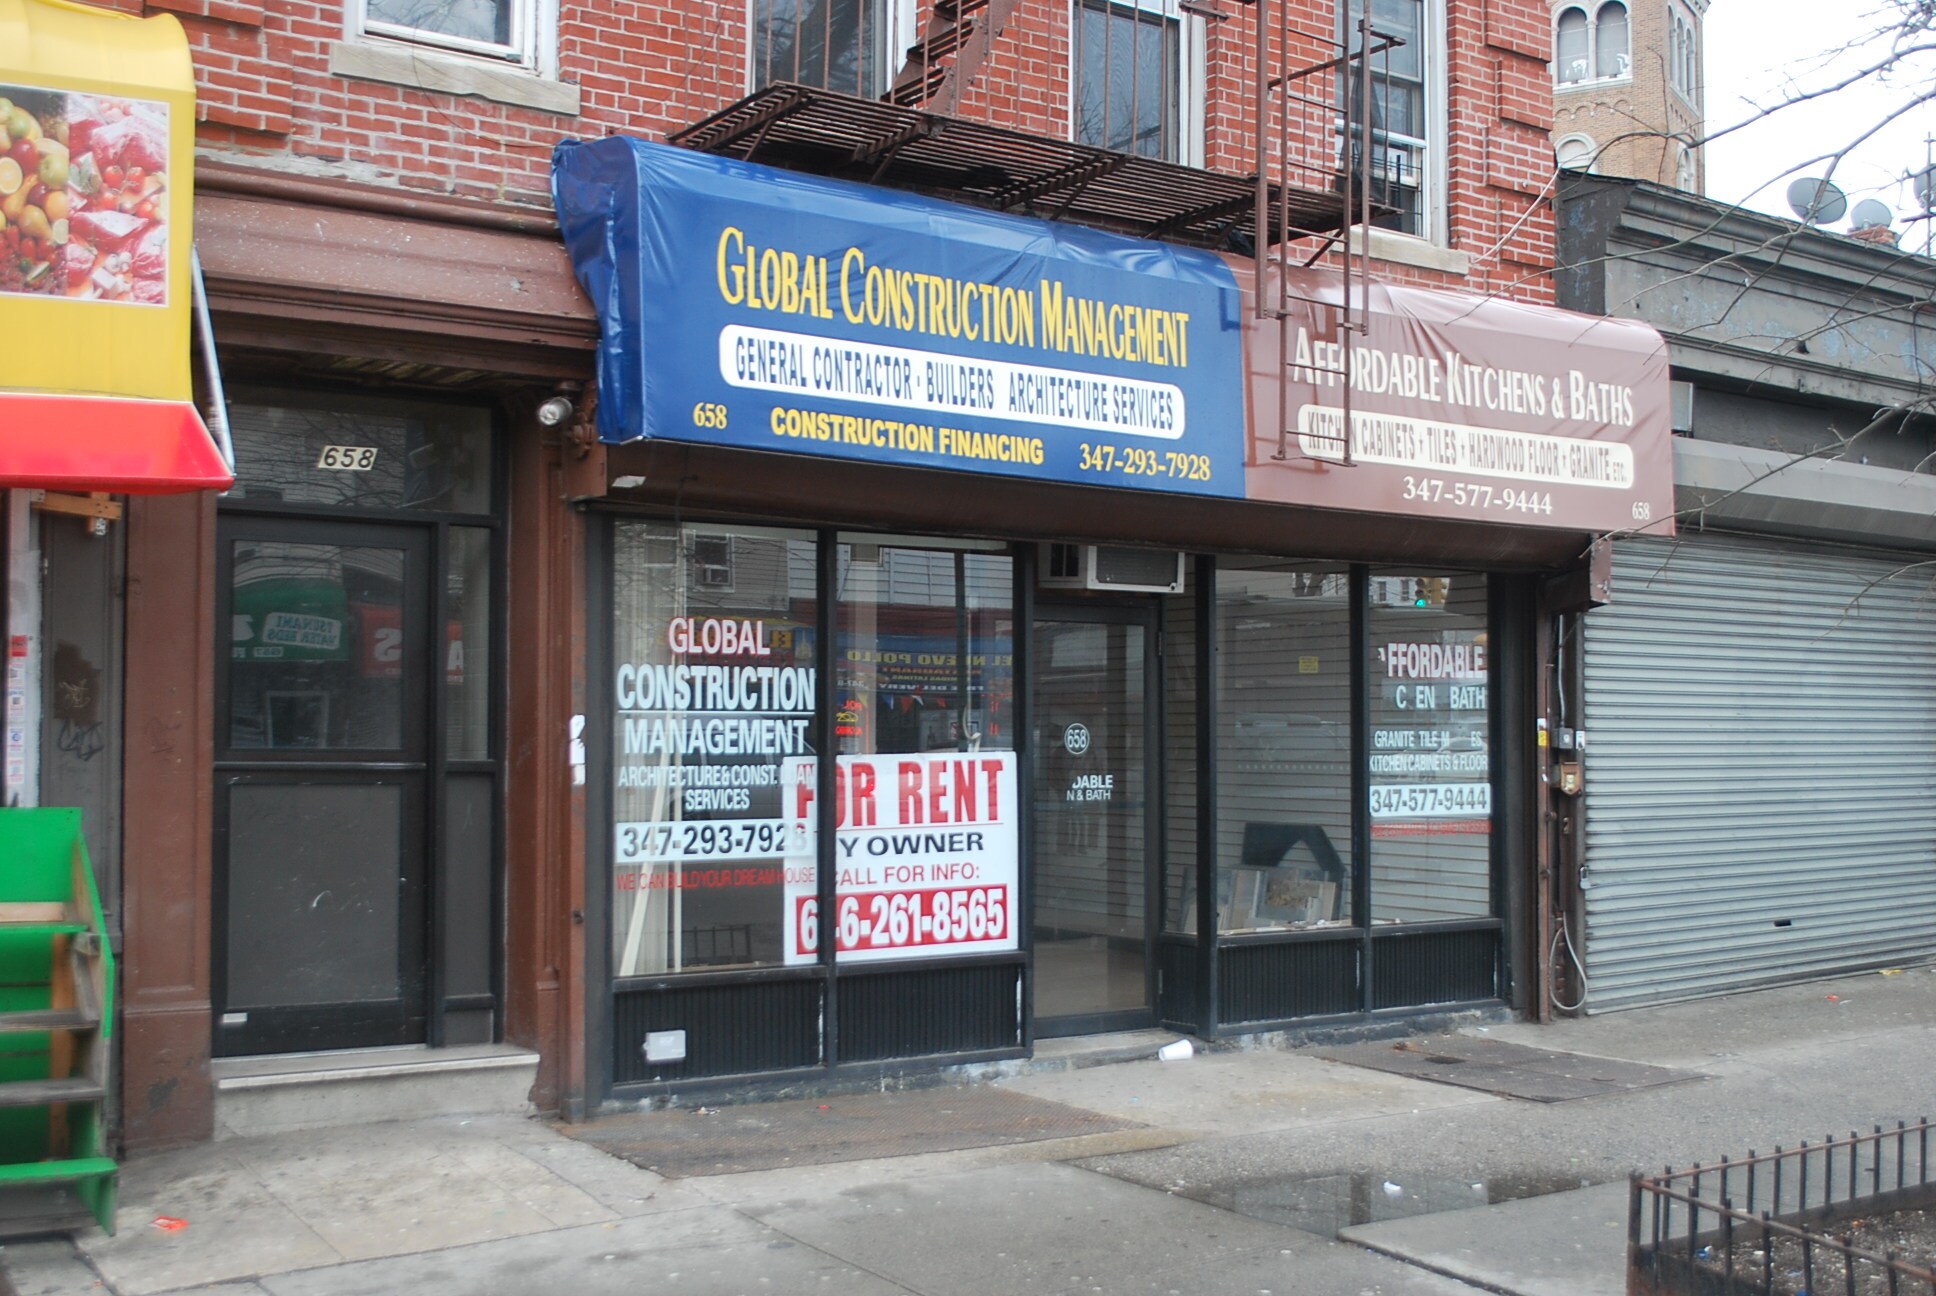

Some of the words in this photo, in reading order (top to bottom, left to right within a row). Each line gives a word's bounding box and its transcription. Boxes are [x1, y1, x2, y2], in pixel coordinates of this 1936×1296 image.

[717, 226, 833, 319] GLOBAL
[840, 246, 1034, 348] CONSTRUCTION
[1040, 279, 1189, 368] MANAGEMENT
[736, 336, 807, 387] GENERAL
[813, 346, 912, 399] CONTRACTOR
[926, 360, 994, 410] BUILDERS
[1008, 371, 1108, 422] ARCHITECTURE
[1113, 384, 1173, 430] SERVICES
[1293, 327, 1441, 402] AFFORDABLE
[1446, 352, 1545, 418] KITCHENS
[1551, 378, 1565, 419] &
[1569, 370, 1633, 427] BATHS
[693, 402, 728, 429] 658
[770, 406, 934, 453] CONSTRUCTION
[939, 427, 1044, 466] FINANCING
[1307, 411, 1357, 454] KITCHN
[1361, 418, 1415, 461] CABINETS
[1426, 427, 1457, 465] TILES
[1469, 431, 1525, 473] HARDWOOD
[1528, 439, 1560, 476] FLOOR
[1569, 443, 1611, 481] GRANITE
[323, 446, 376, 469] 658
[1079, 443, 1211, 482] 347-293-7928
[1403, 476, 1553, 515] 347-577-9444
[1631, 501, 1650, 521] 658
[668, 616, 771, 656] GLOBAL
[617, 662, 816, 711] CONSTRUCTION
[1449, 686, 1486, 709] BATH
[624, 718, 809, 754] MANAGEMENT
[1067, 729, 1087, 748] 658
[1374, 730, 1415, 748] GRANITE
[1419, 730, 1438, 747] TILE
[1369, 755, 1407, 772] KITCHEN
[1408, 754, 1451, 771] CABINETS
[685, 788, 750, 811] SERVICES
[898, 759, 1004, 825] RENT
[1085, 789, 1111, 801] BATH
[1371, 787, 1487, 813] 347-577-9444
[622, 822, 808, 858] 347-293-7928
[867, 832, 984, 856] OWNER
[616, 873, 635, 890] WE
[640, 872, 665, 889] CAN
[698, 869, 732, 887] YOUR
[734, 867, 779, 886] DREAM
[779, 866, 815, 885] HOUSE
[836, 864, 878, 887] ALL
[884, 864, 925, 883] FOR
[931, 862, 980, 881] INFO:
[801, 888, 1004, 951] 66-261-8565
